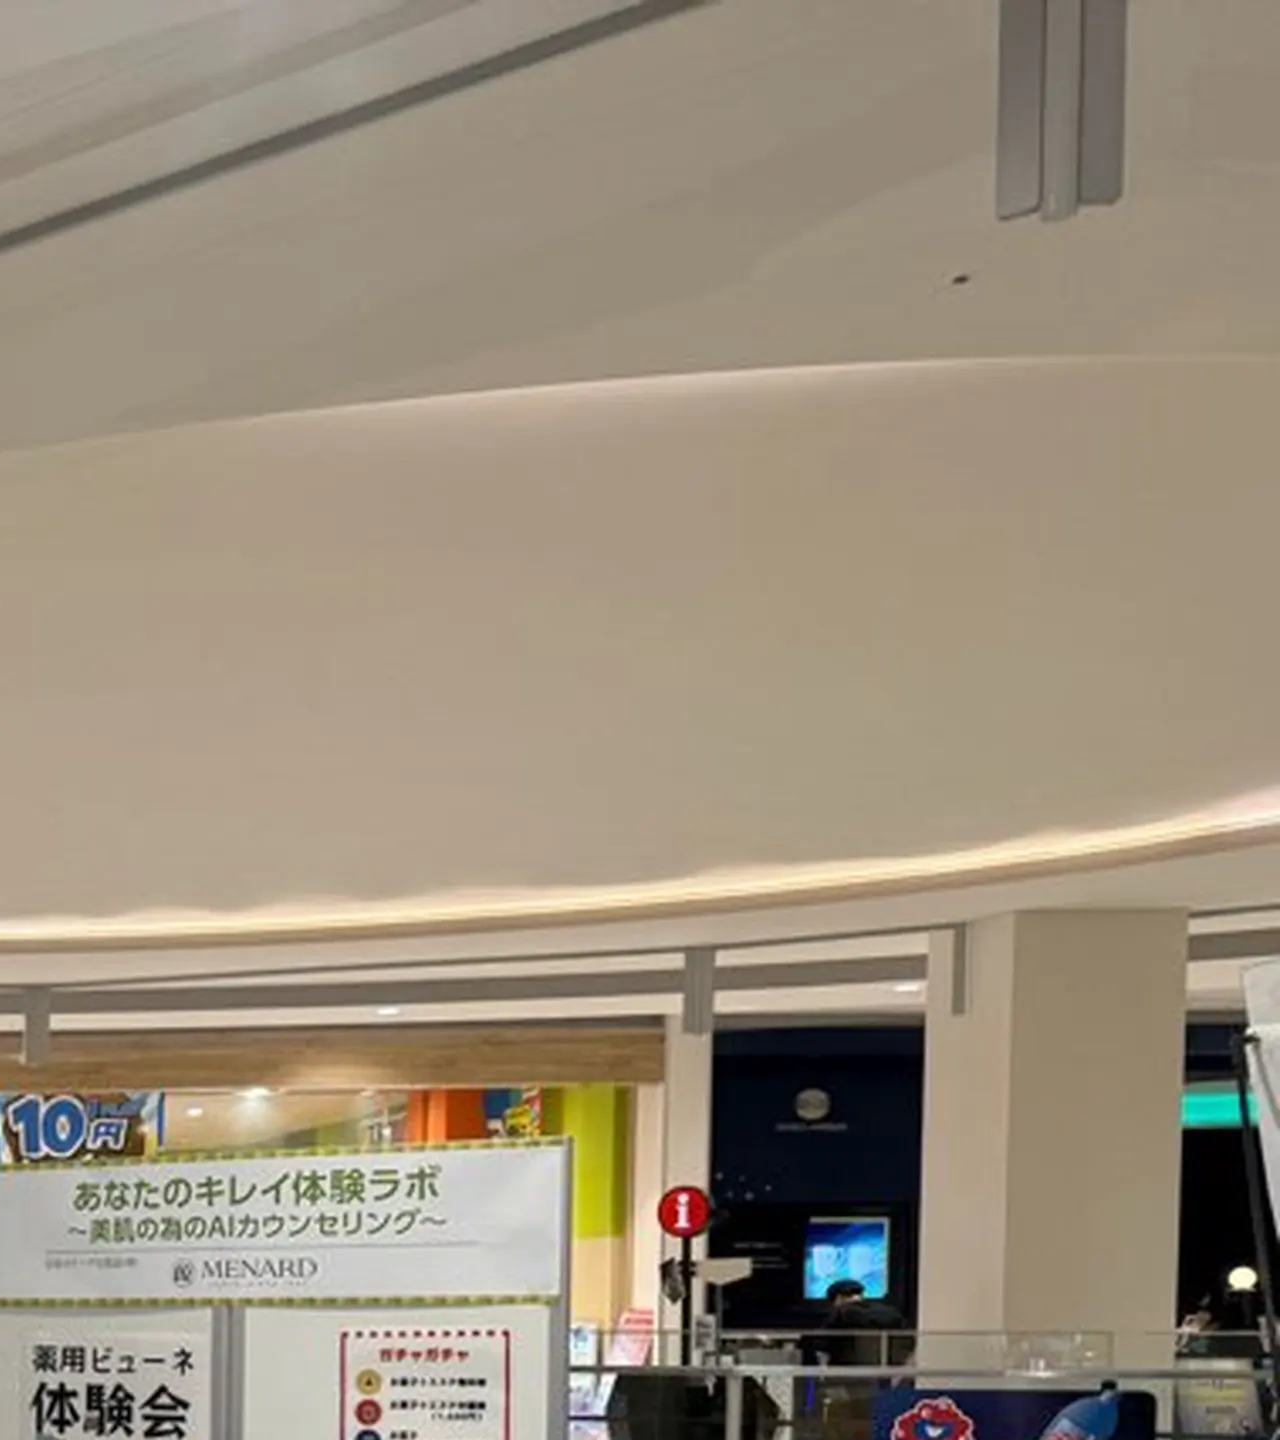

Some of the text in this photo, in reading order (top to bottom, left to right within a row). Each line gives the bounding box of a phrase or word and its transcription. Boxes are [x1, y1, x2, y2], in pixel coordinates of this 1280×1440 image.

[8, 1094, 128, 1158] 10円
[73, 1164, 441, 1212] あなたのキレイ体験ラボ
[201, 1255, 319, 1280] MENARD
[32, 1345, 194, 1375] 薬用ビューネ
[30, 1381, 191, 1440] 体験会
